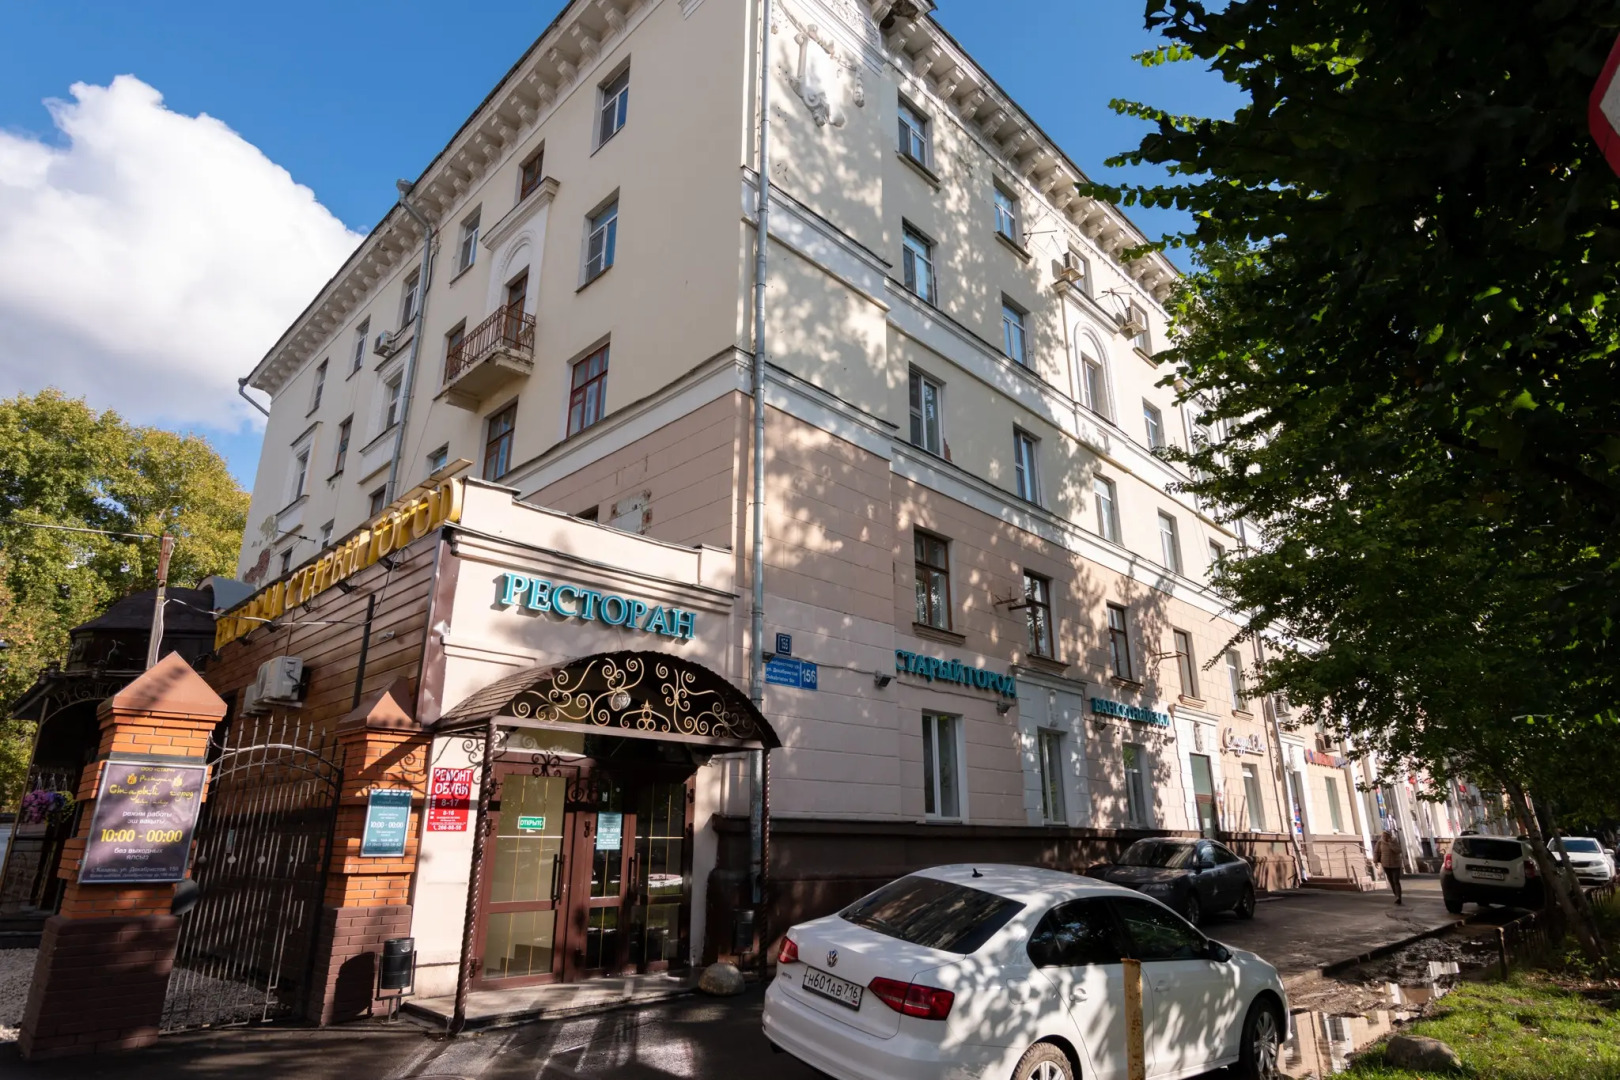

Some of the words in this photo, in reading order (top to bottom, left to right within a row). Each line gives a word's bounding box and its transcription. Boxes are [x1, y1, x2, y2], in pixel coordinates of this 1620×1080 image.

[367, 477, 463, 565] ГОРОД
[502, 572, 697, 640] РЕСТОРАН
[802, 668, 816, 683] 156
[895, 649, 964, 683] СТАРЫЙ
[965, 666, 1017, 698] ГОРОД
[435, 769, 472, 782] РЕМОНТ
[435, 782, 469, 795] ОБУВИ
[441, 798, 459, 807] 8-17
[101, 829, 135, 842] 10:00
[146, 829, 183, 842] 00:00
